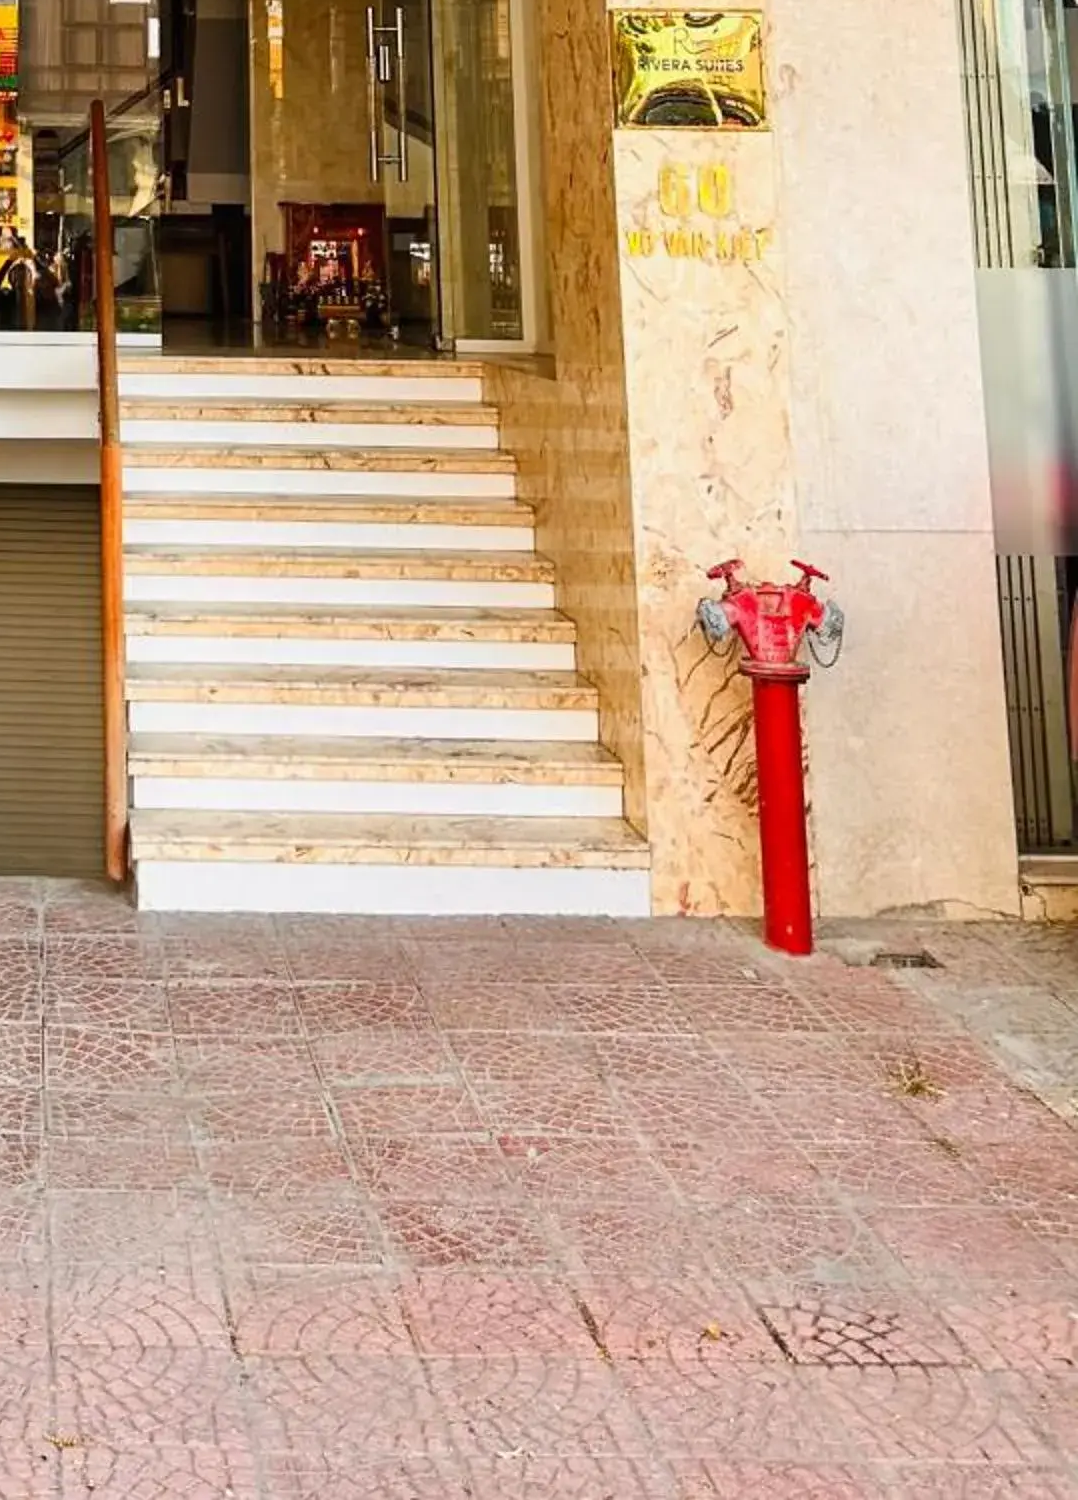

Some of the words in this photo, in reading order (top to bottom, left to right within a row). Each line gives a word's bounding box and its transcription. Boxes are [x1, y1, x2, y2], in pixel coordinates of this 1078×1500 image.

[637, 59, 692, 72] RIVERA
[695, 59, 744, 72] SUITES
[658, 160, 731, 217] 60
